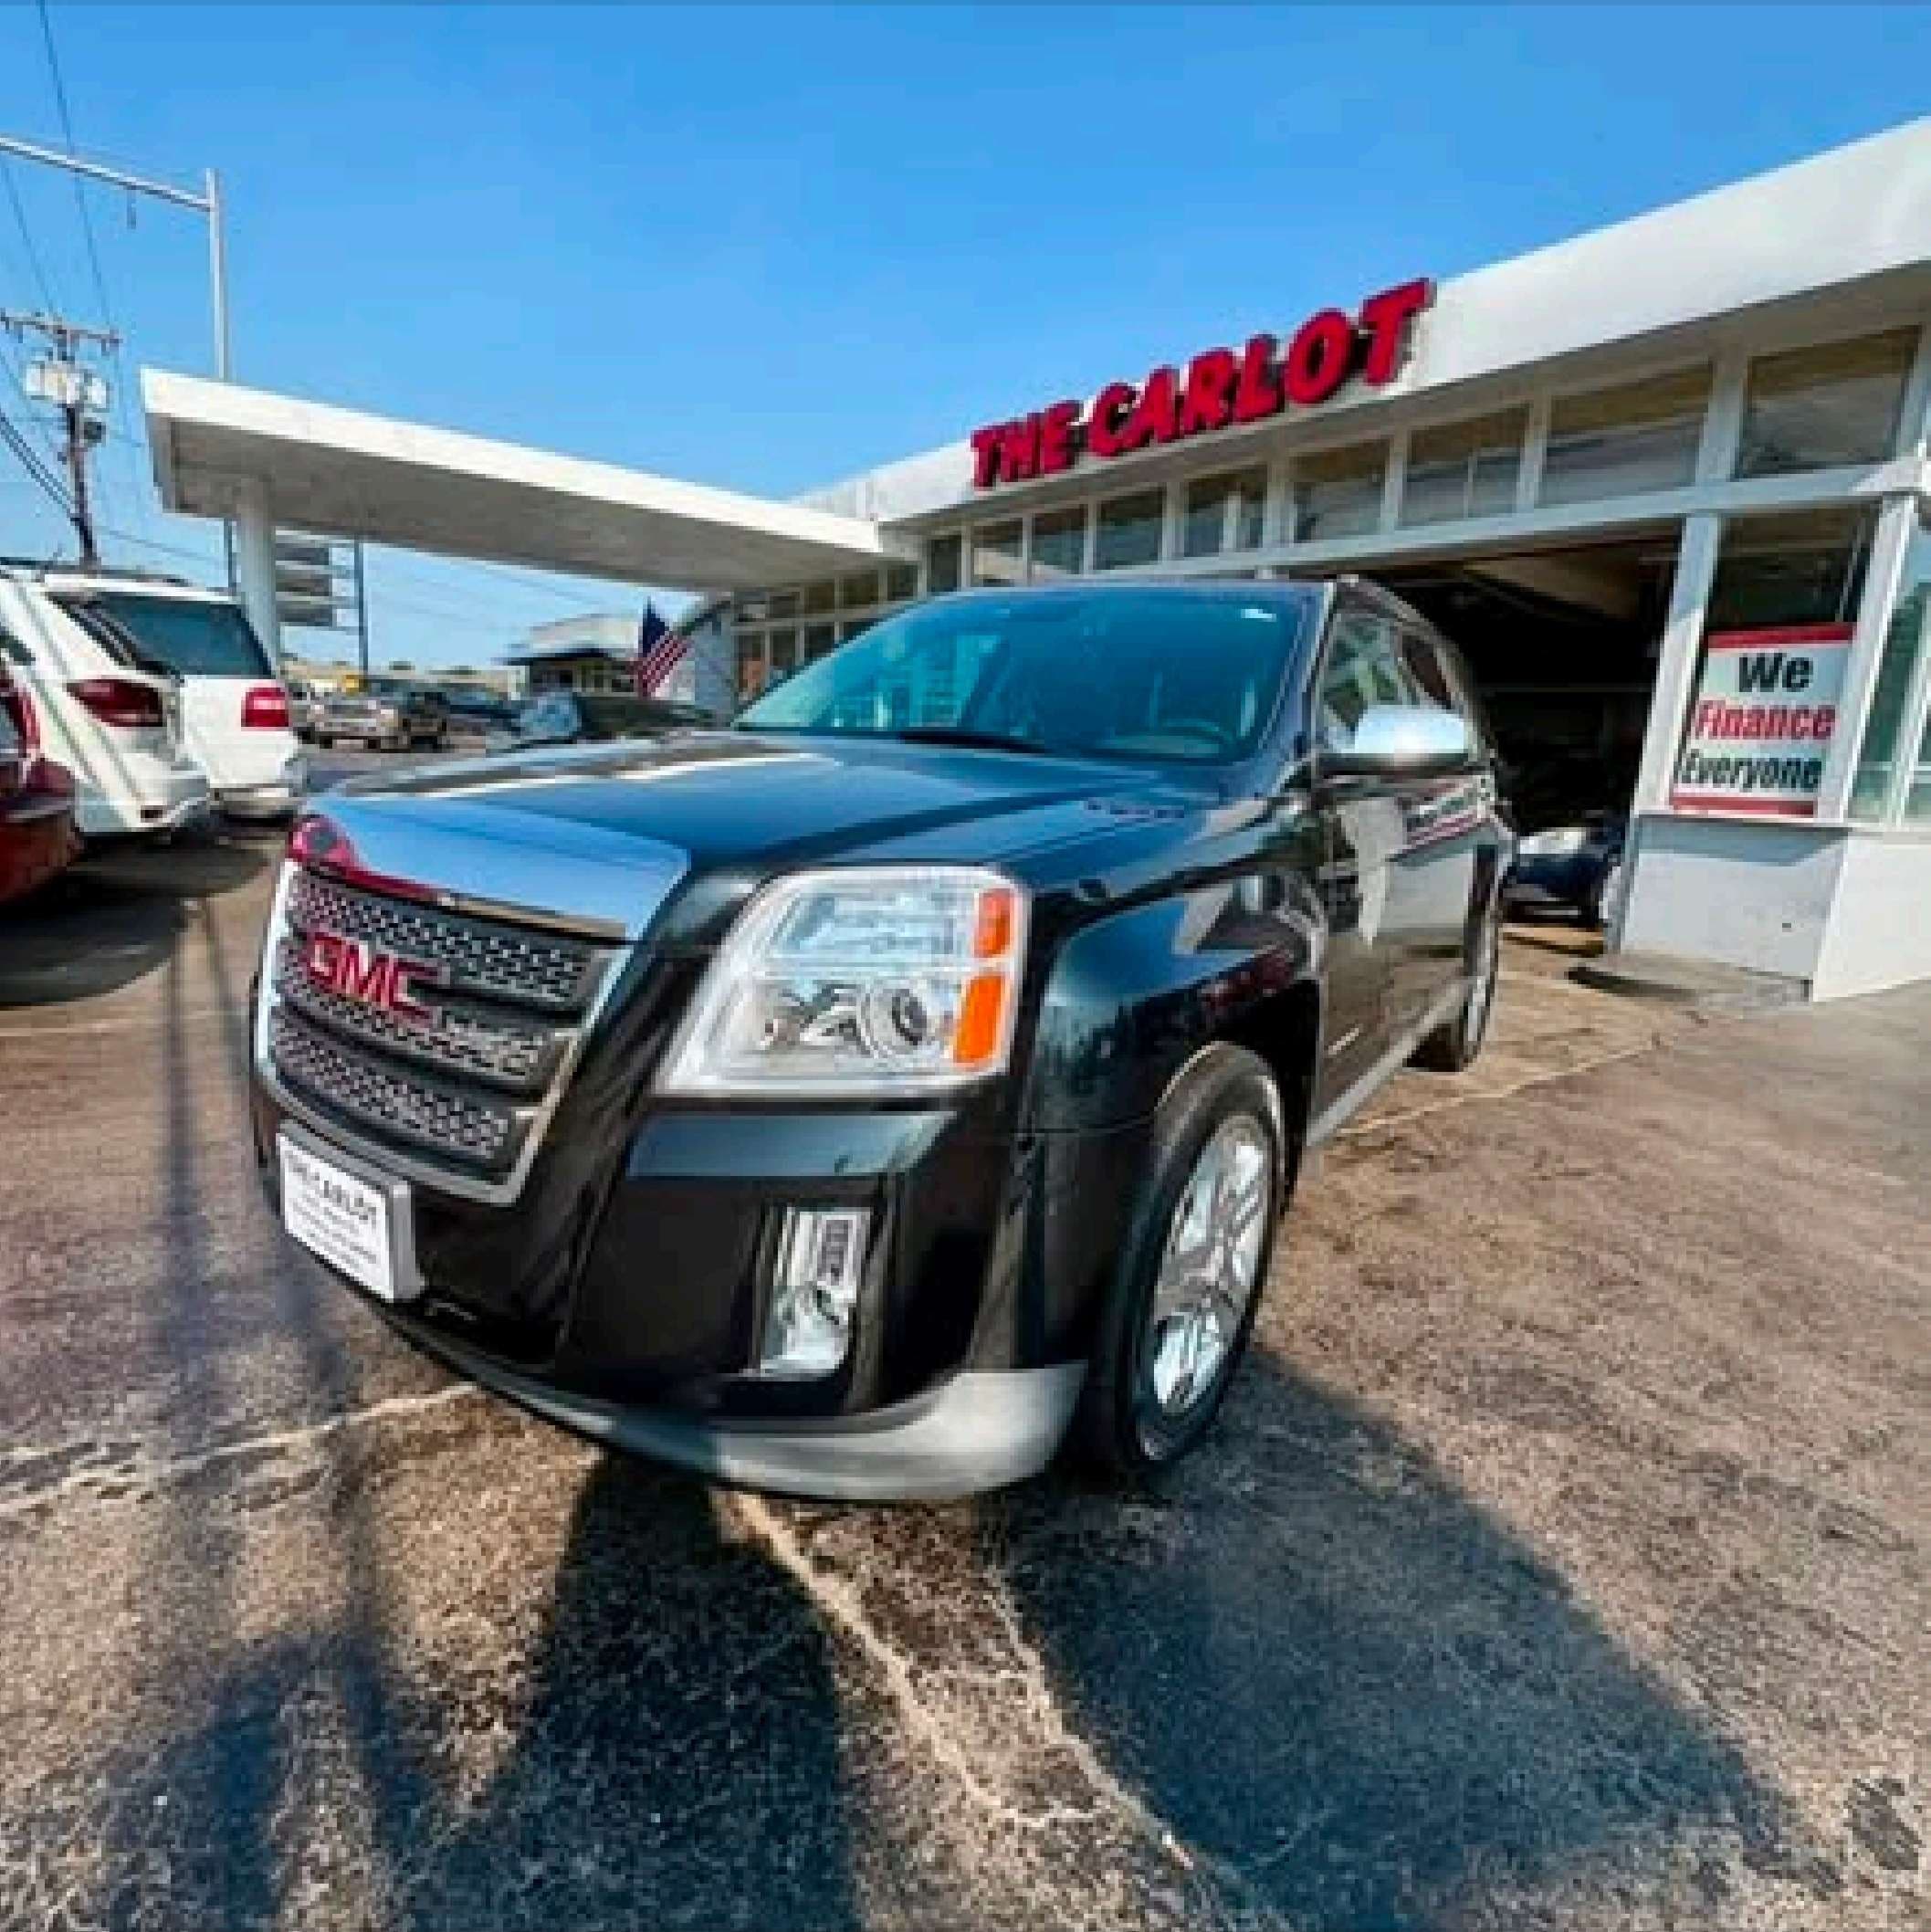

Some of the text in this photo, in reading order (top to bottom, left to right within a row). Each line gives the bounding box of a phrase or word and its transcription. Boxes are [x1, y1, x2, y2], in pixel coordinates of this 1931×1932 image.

[971, 277, 1432, 488] THE CARLOT
[1738, 652, 1814, 693] We
[1695, 699, 1837, 740] Finance
[1680, 749, 1823, 793] Everyone
[306, 930, 442, 1026] GMC
